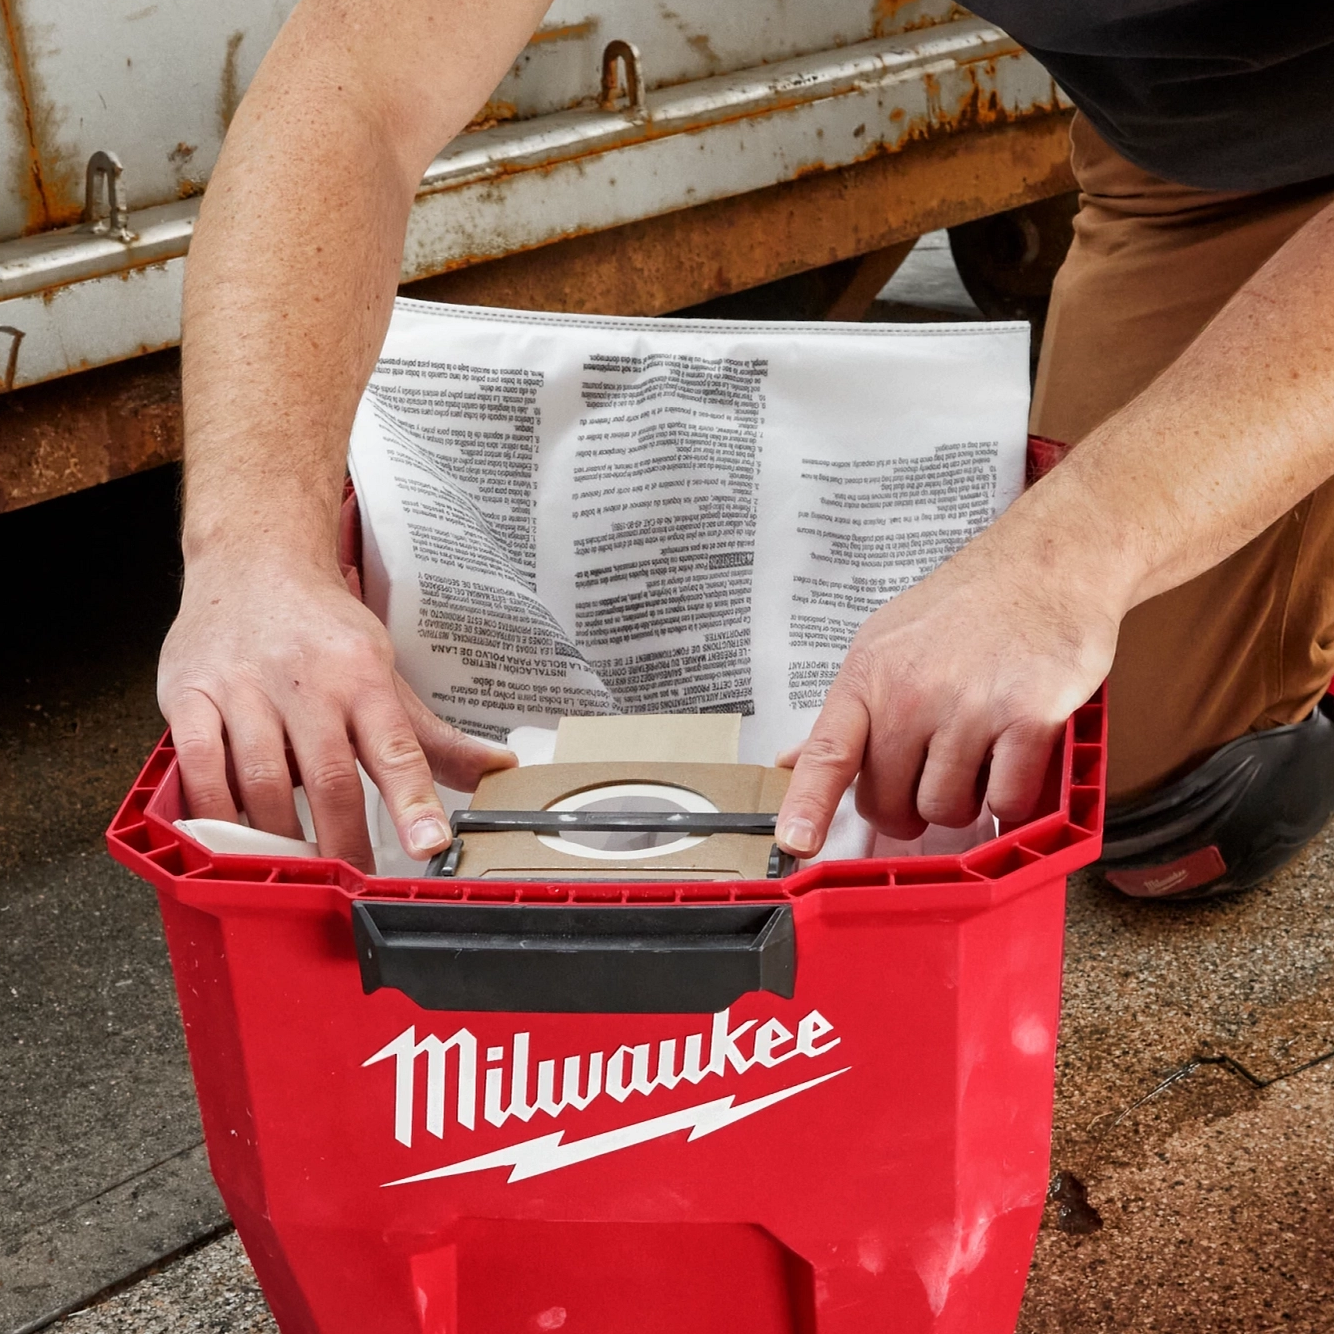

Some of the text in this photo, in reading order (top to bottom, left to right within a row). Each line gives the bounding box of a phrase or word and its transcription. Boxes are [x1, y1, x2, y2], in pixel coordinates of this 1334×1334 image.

[430, 644, 581, 670] LA BOLSA PARA POLVO DE LANA
[461, 657, 496, 669] RETIRO
[502, 664, 566, 676] INSTALACIÓN
[361, 1007, 841, 1148] Milwaukee
